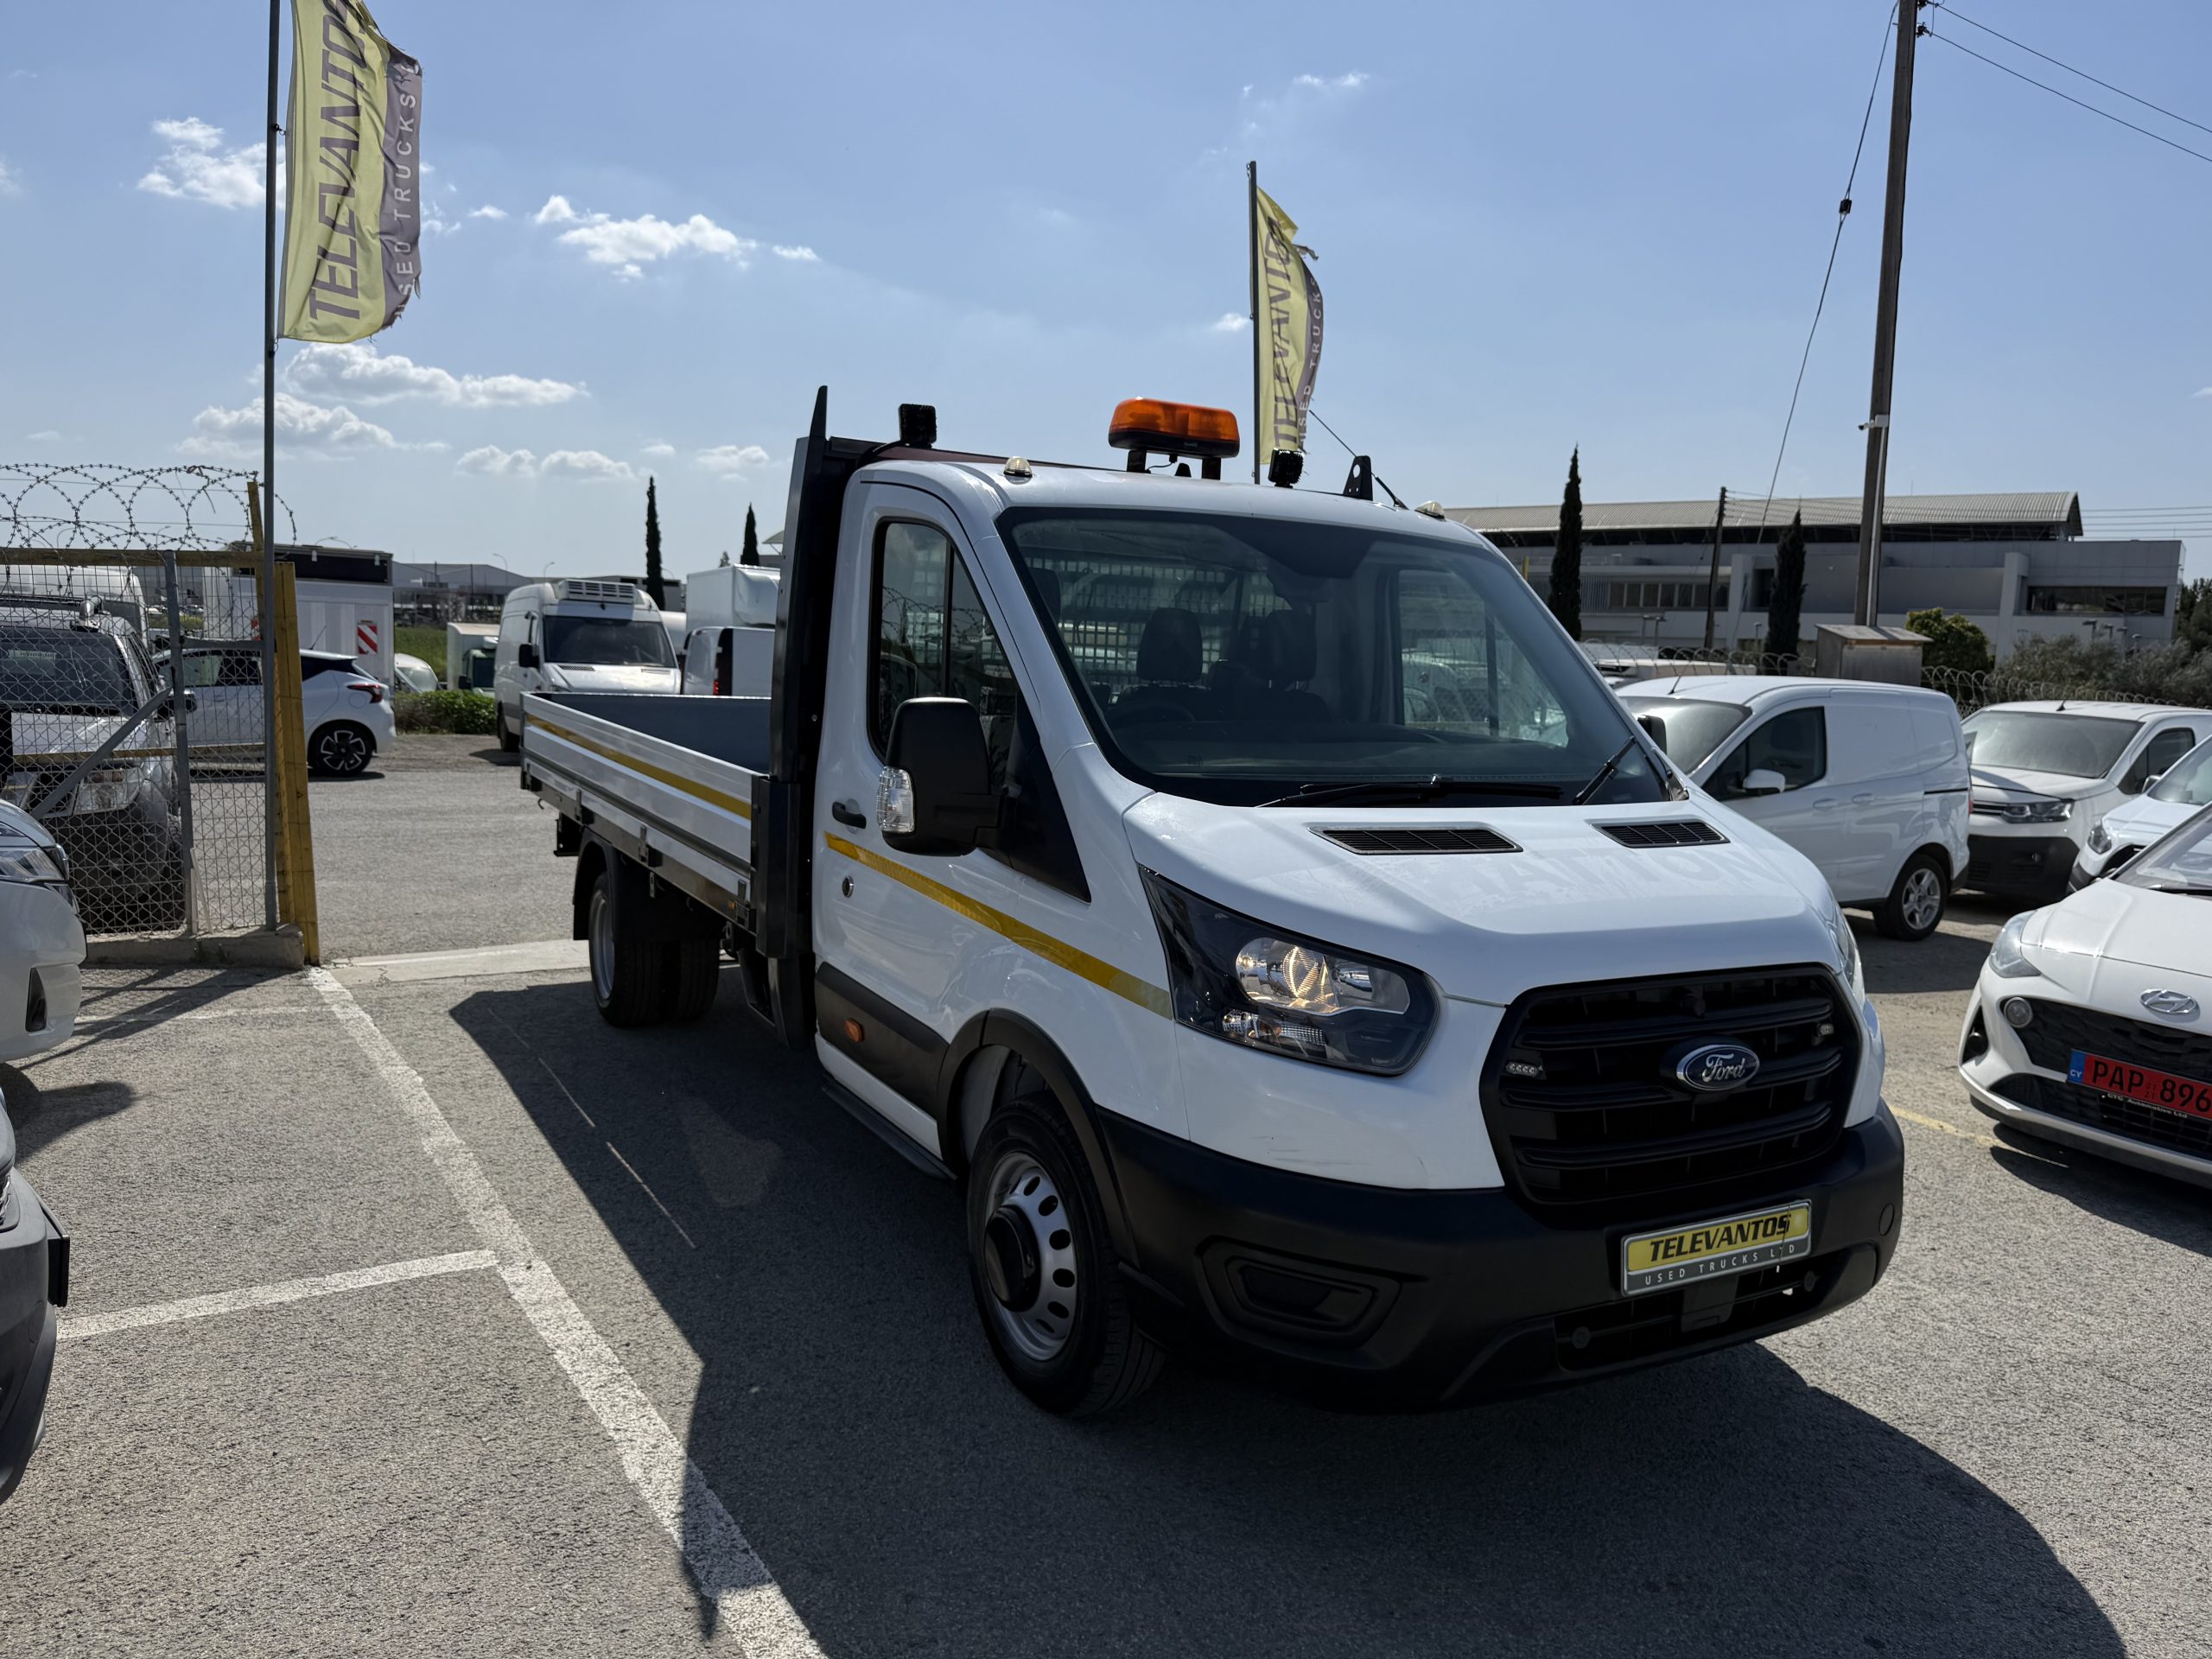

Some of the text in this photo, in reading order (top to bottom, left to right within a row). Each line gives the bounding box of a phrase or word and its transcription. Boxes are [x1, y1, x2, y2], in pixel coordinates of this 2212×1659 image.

[394, 93, 416, 221] TRUCKS
[1701, 1053, 1745, 1083] Ford
[2069, 1069, 2083, 1078] CY
[2092, 1059, 2212, 1113] PAP 896
[2127, 1098, 2172, 1115] Automotive
[2173, 1110, 2189, 1119] Ltd
[1649, 1213, 1792, 1262] TELEVANTOS
[1645, 1268, 1686, 1286] USED
[1699, 1252, 1759, 1274] TRUCKS
